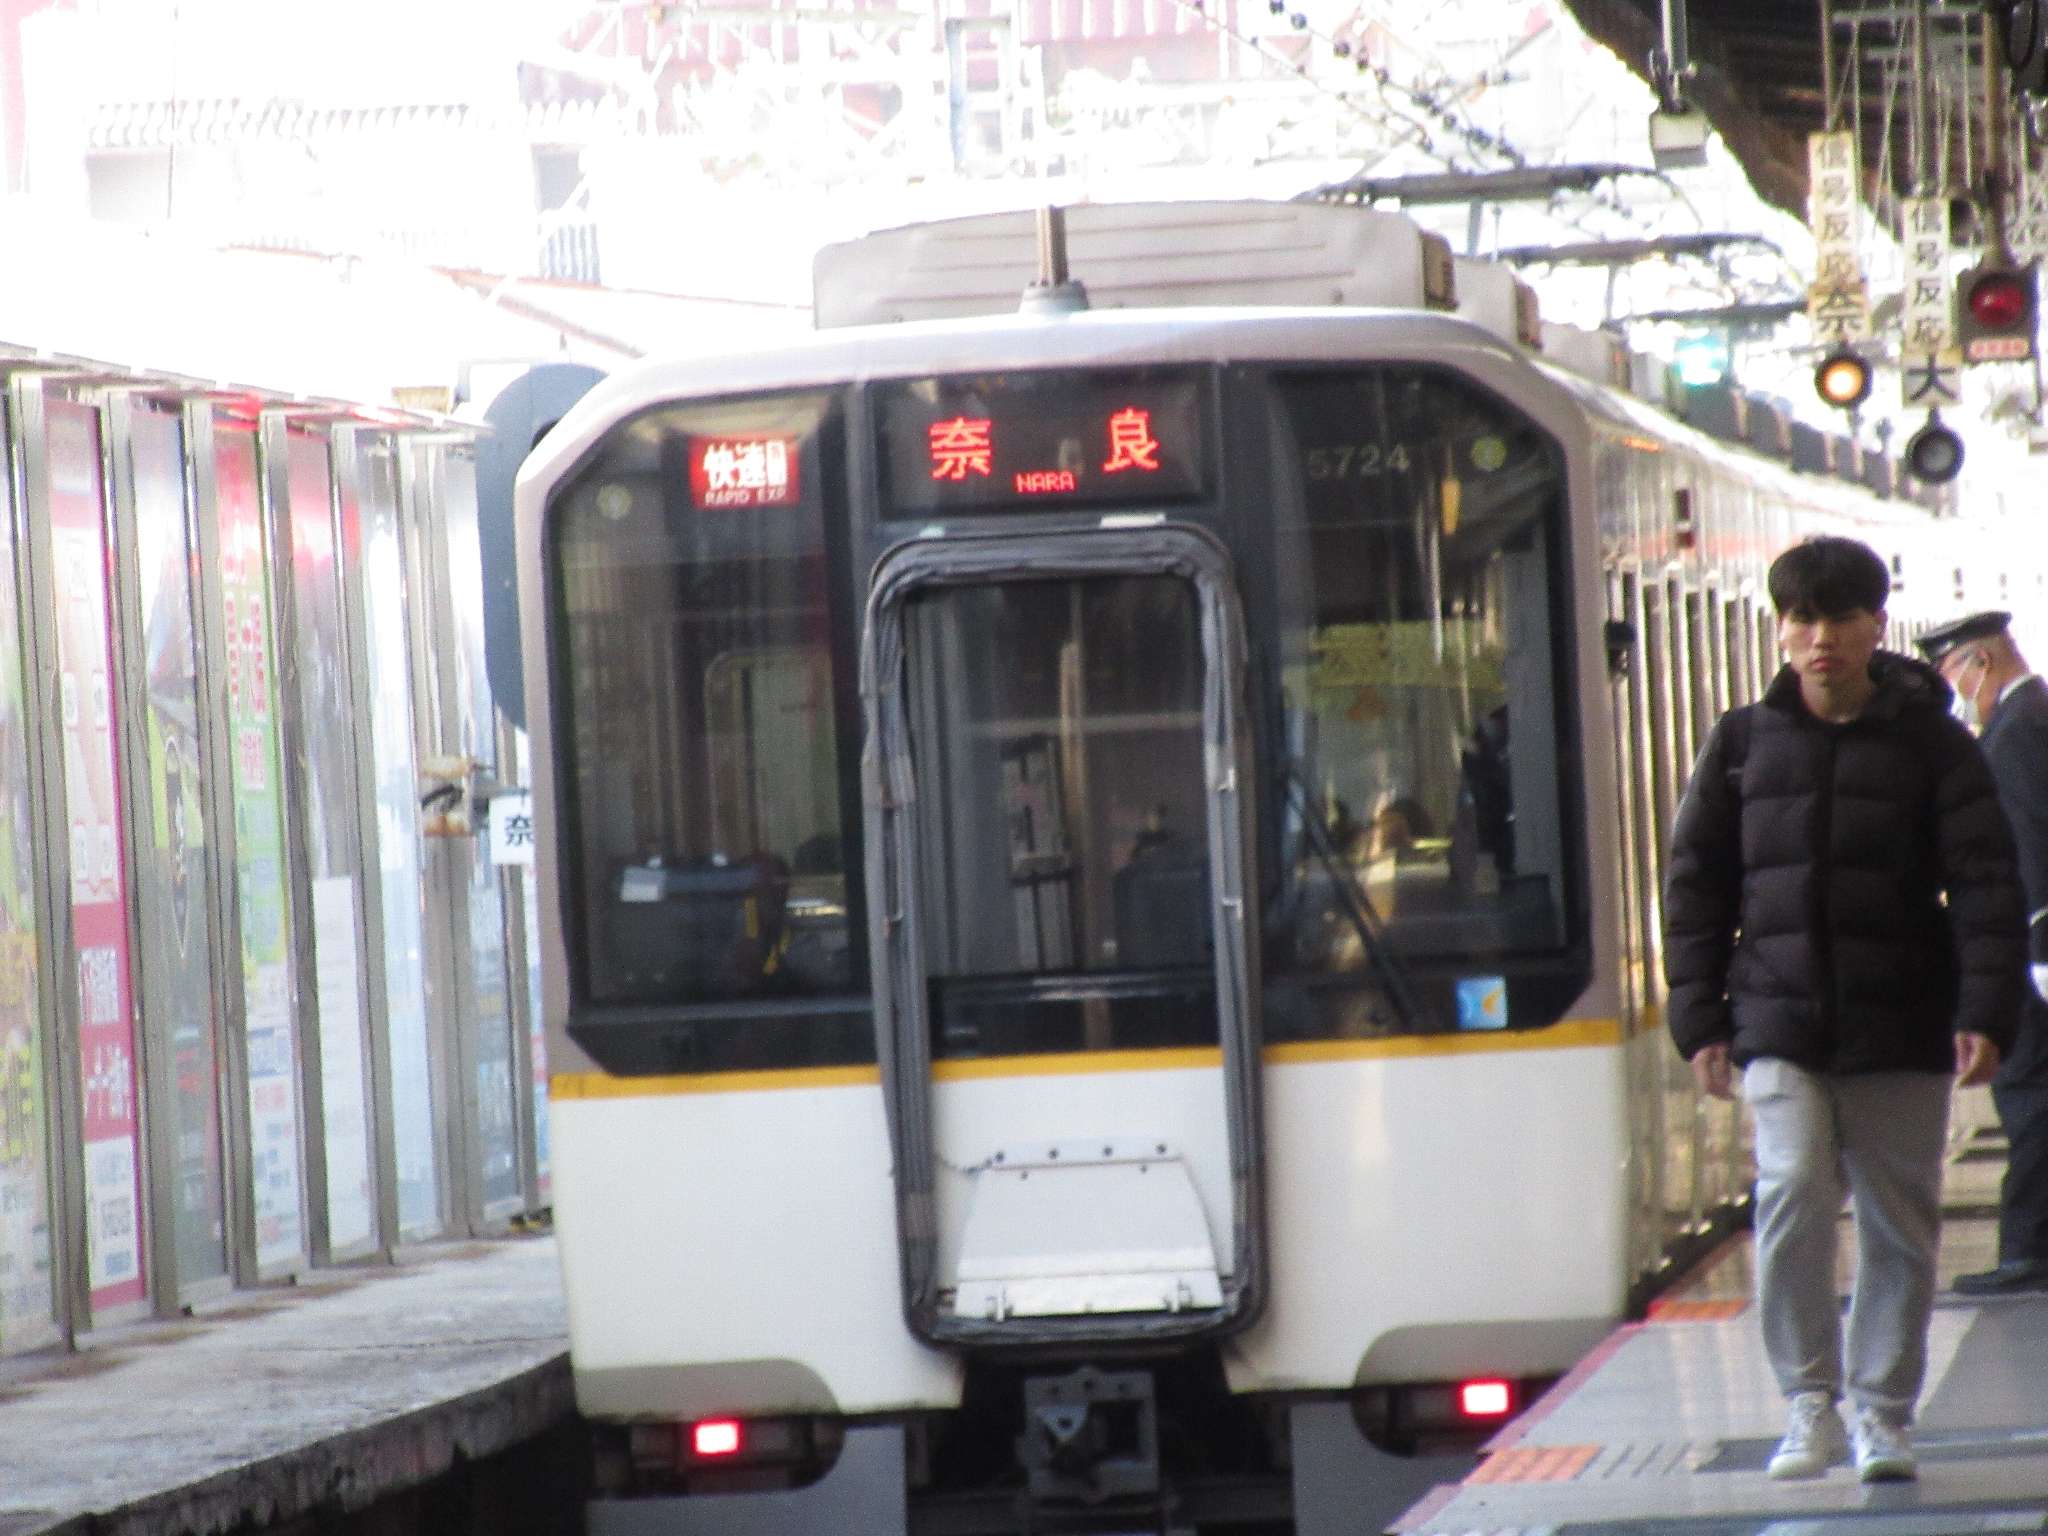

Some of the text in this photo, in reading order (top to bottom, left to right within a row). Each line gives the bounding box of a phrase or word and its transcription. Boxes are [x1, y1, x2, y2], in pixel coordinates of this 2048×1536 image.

[1903, 352, 1958, 402] 大
[929, 406, 1161, 481] 奈 良
[704, 486, 787, 506] RAPID EXP
[1014, 471, 1077, 493] NARA
